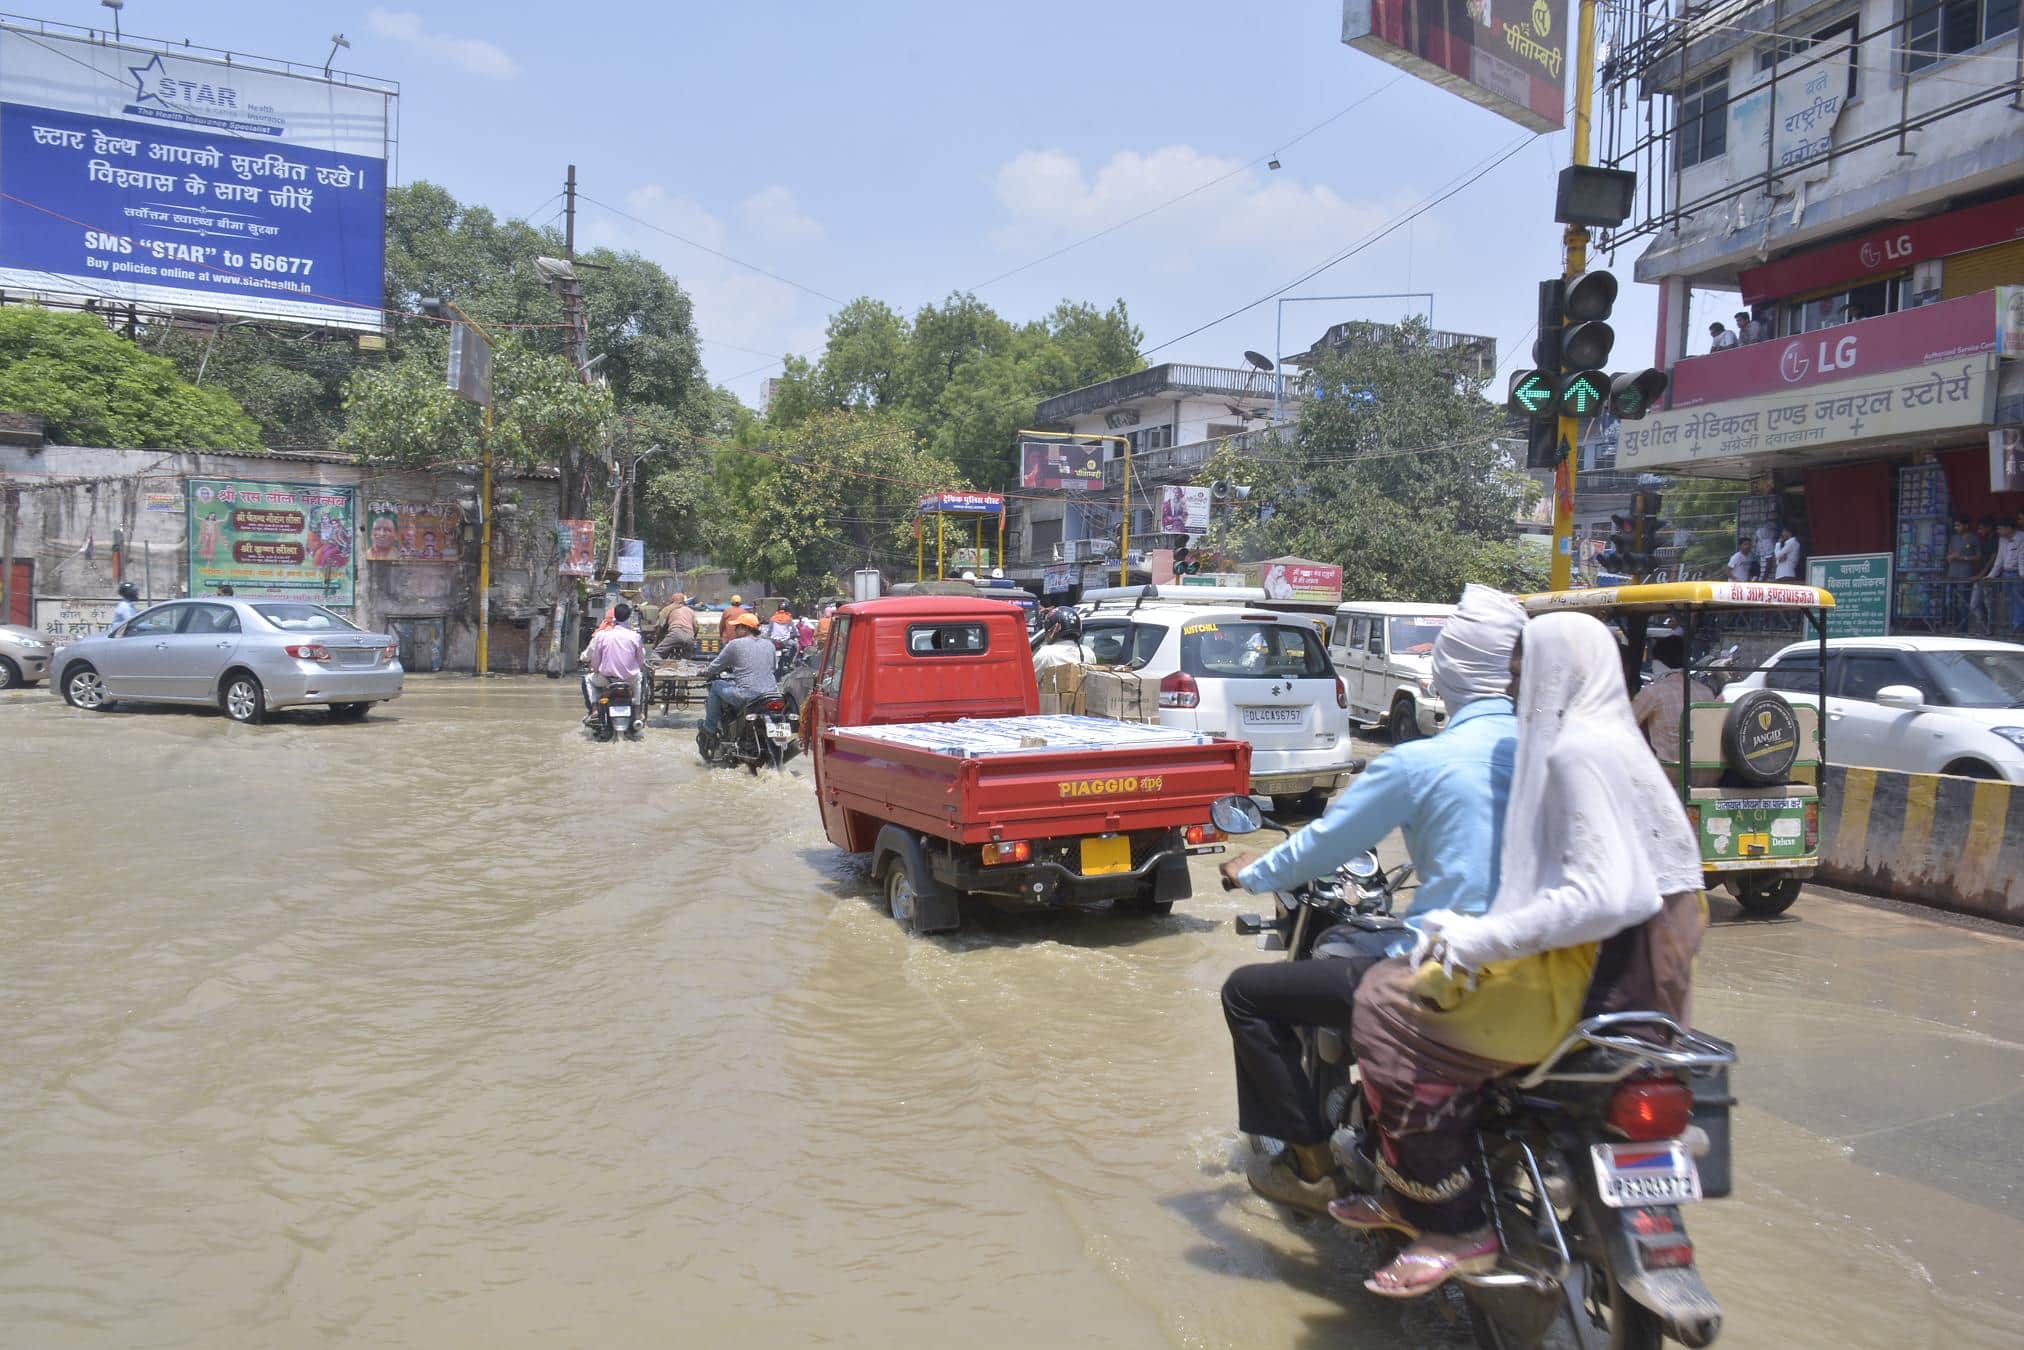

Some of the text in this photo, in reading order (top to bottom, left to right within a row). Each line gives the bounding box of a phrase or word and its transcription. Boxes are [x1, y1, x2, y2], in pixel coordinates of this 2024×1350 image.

[1502, 22, 1562, 79] पीताम्बरी
[159, 77, 238, 109] STAR
[154, 110, 183, 120] Health
[31, 125, 86, 151] स्टार
[90, 129, 141, 157] हेल्थ
[148, 141, 223, 169] आपको
[230, 153, 310, 182] सुरक्षित
[88, 159, 314, 214] विश्वास के साथ जीएँ
[216, 217, 246, 231] बीमा
[247, 222, 280, 237] सुरक्षा
[84, 231, 133, 255] SMS
[223, 250, 244, 268] to
[249, 252, 314, 276] 56677
[1885, 234, 1913, 261] LG
[86, 256, 312, 294] Buy policies online at www.starhealth.in
[1817, 334, 1858, 374] LG
[1624, 364, 1973, 457] सुशील मेडिकल एण्ड जनरल स्टोर्स
[1719, 426, 1827, 453] अंग्रेजी दवाखाना
[217, 485, 237, 503] श्री
[240, 490, 262, 503] रास
[265, 489, 297, 505] लीला
[46, 619, 65, 635] श्री
[1183, 624, 1198, 635] JUST
[1753, 728, 1782, 748] JANGID
[1058, 777, 1138, 798] PIAGGIO
[1772, 837, 1796, 847] Deluxe
